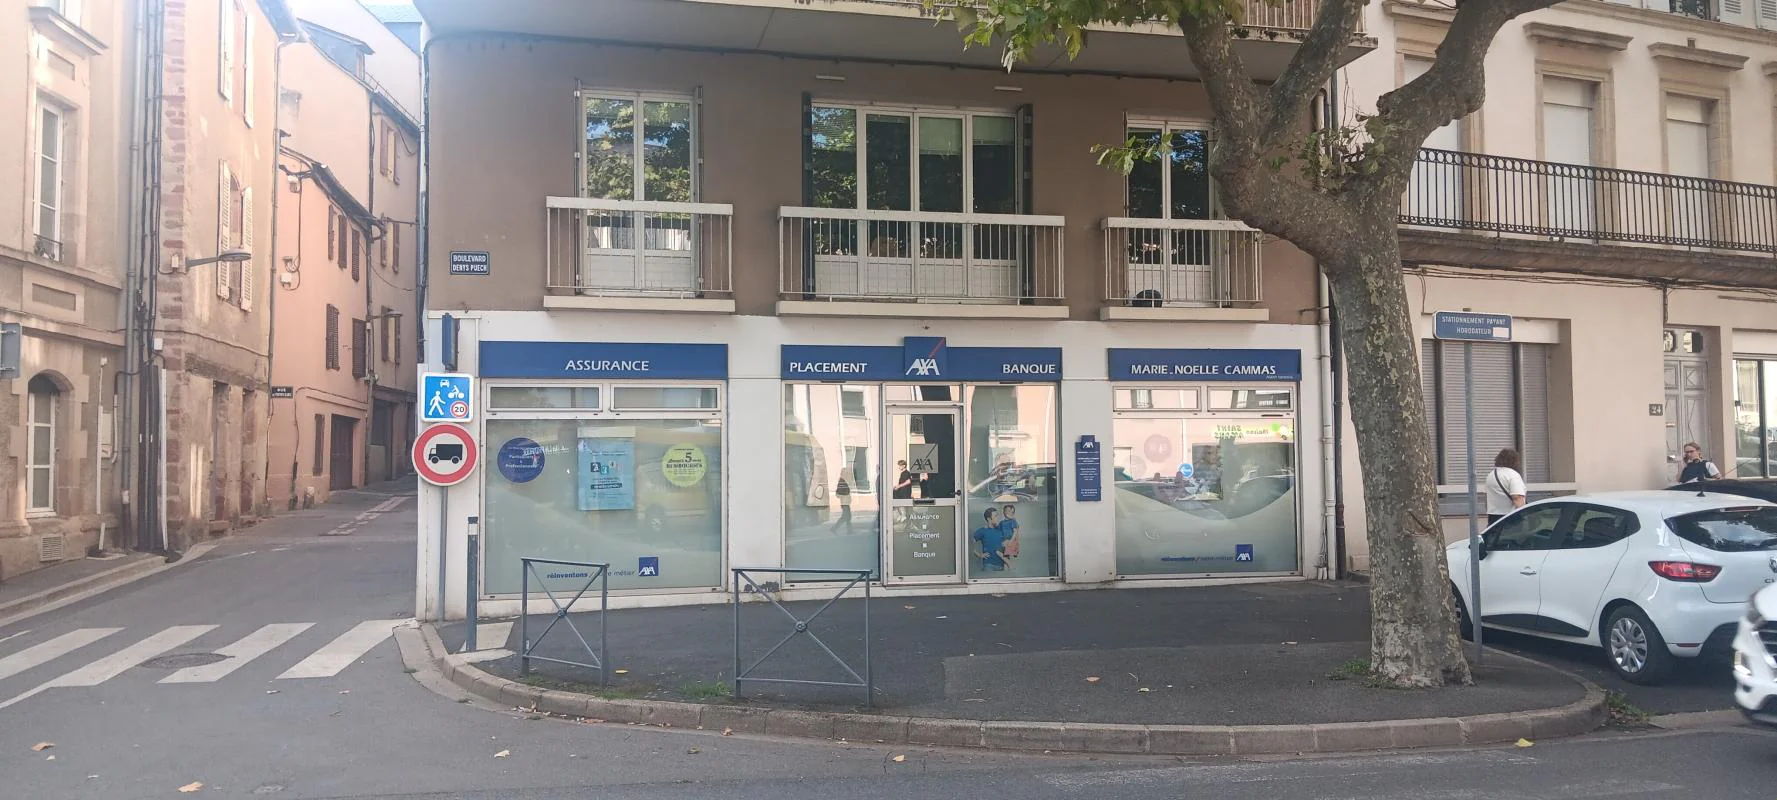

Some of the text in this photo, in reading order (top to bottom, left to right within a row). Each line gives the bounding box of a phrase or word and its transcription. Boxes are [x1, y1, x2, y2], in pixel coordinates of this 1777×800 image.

[1441, 316, 1484, 324] STATIONNEMENT
[565, 360, 650, 371] ASSURANCE
[790, 362, 868, 373] PLACEMENT
[906, 359, 940, 375] AXA
[1002, 364, 1056, 375] BANQUE
[1224, 365, 1276, 375] CAMMAS
[910, 458, 933, 470] AXA
[639, 566, 655, 575] AXA
